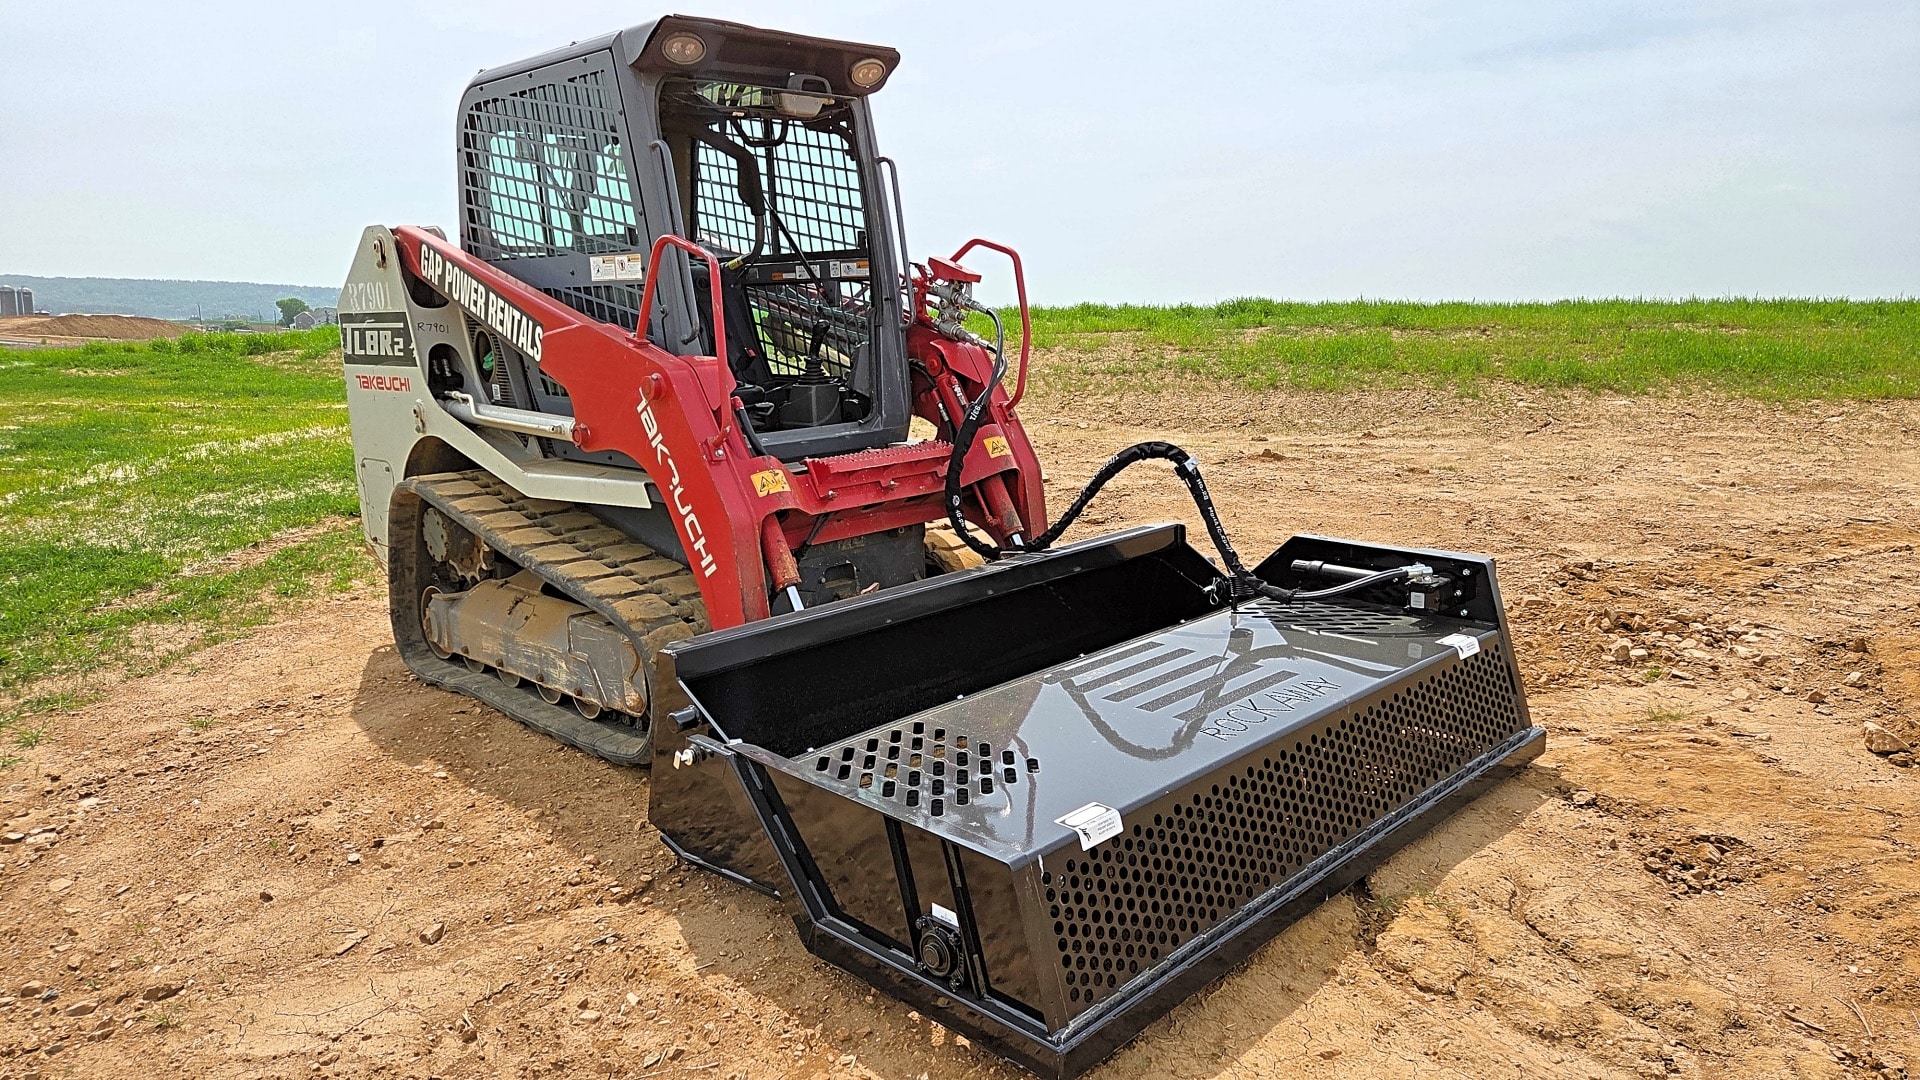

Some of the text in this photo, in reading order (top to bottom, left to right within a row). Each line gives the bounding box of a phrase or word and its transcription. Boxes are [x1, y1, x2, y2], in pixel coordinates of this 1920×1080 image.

[348, 281, 392, 312] R7901
[421, 243, 543, 362] GAP POWER RENTALS
[417, 322, 449, 334] R7901
[356, 375, 411, 392] TAKEUCHI
[1200, 677, 1341, 741] ROCKAWAY
